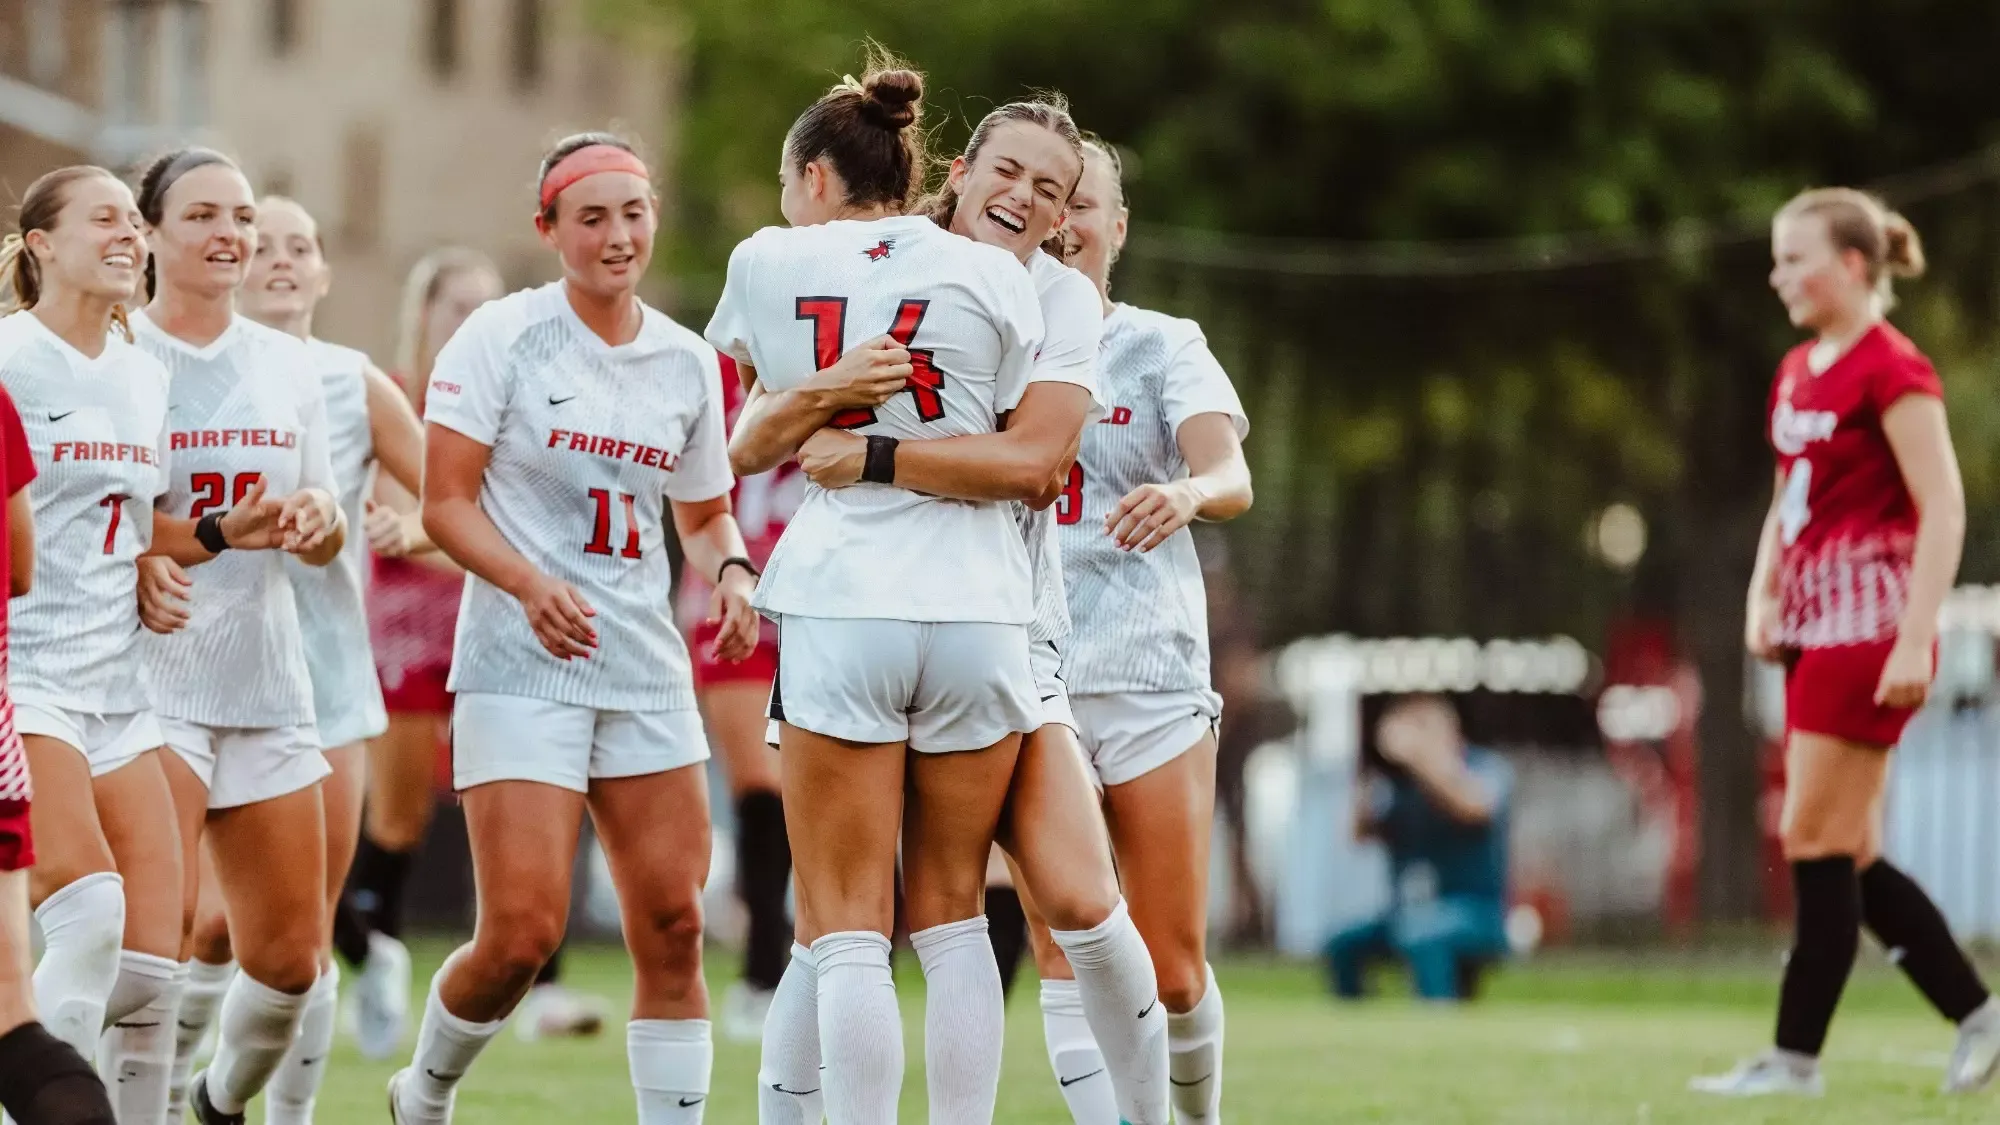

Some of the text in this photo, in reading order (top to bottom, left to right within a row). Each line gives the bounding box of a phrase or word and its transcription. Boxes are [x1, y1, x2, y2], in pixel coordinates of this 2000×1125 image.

[796, 296, 945, 429] 14
[51, 441, 160, 468] FAIRFIEL
[171, 429, 296, 450] AIRFIELD
[584, 488, 642, 559] 11
[1055, 460, 1084, 525] 3
[99, 494, 133, 554] 7
